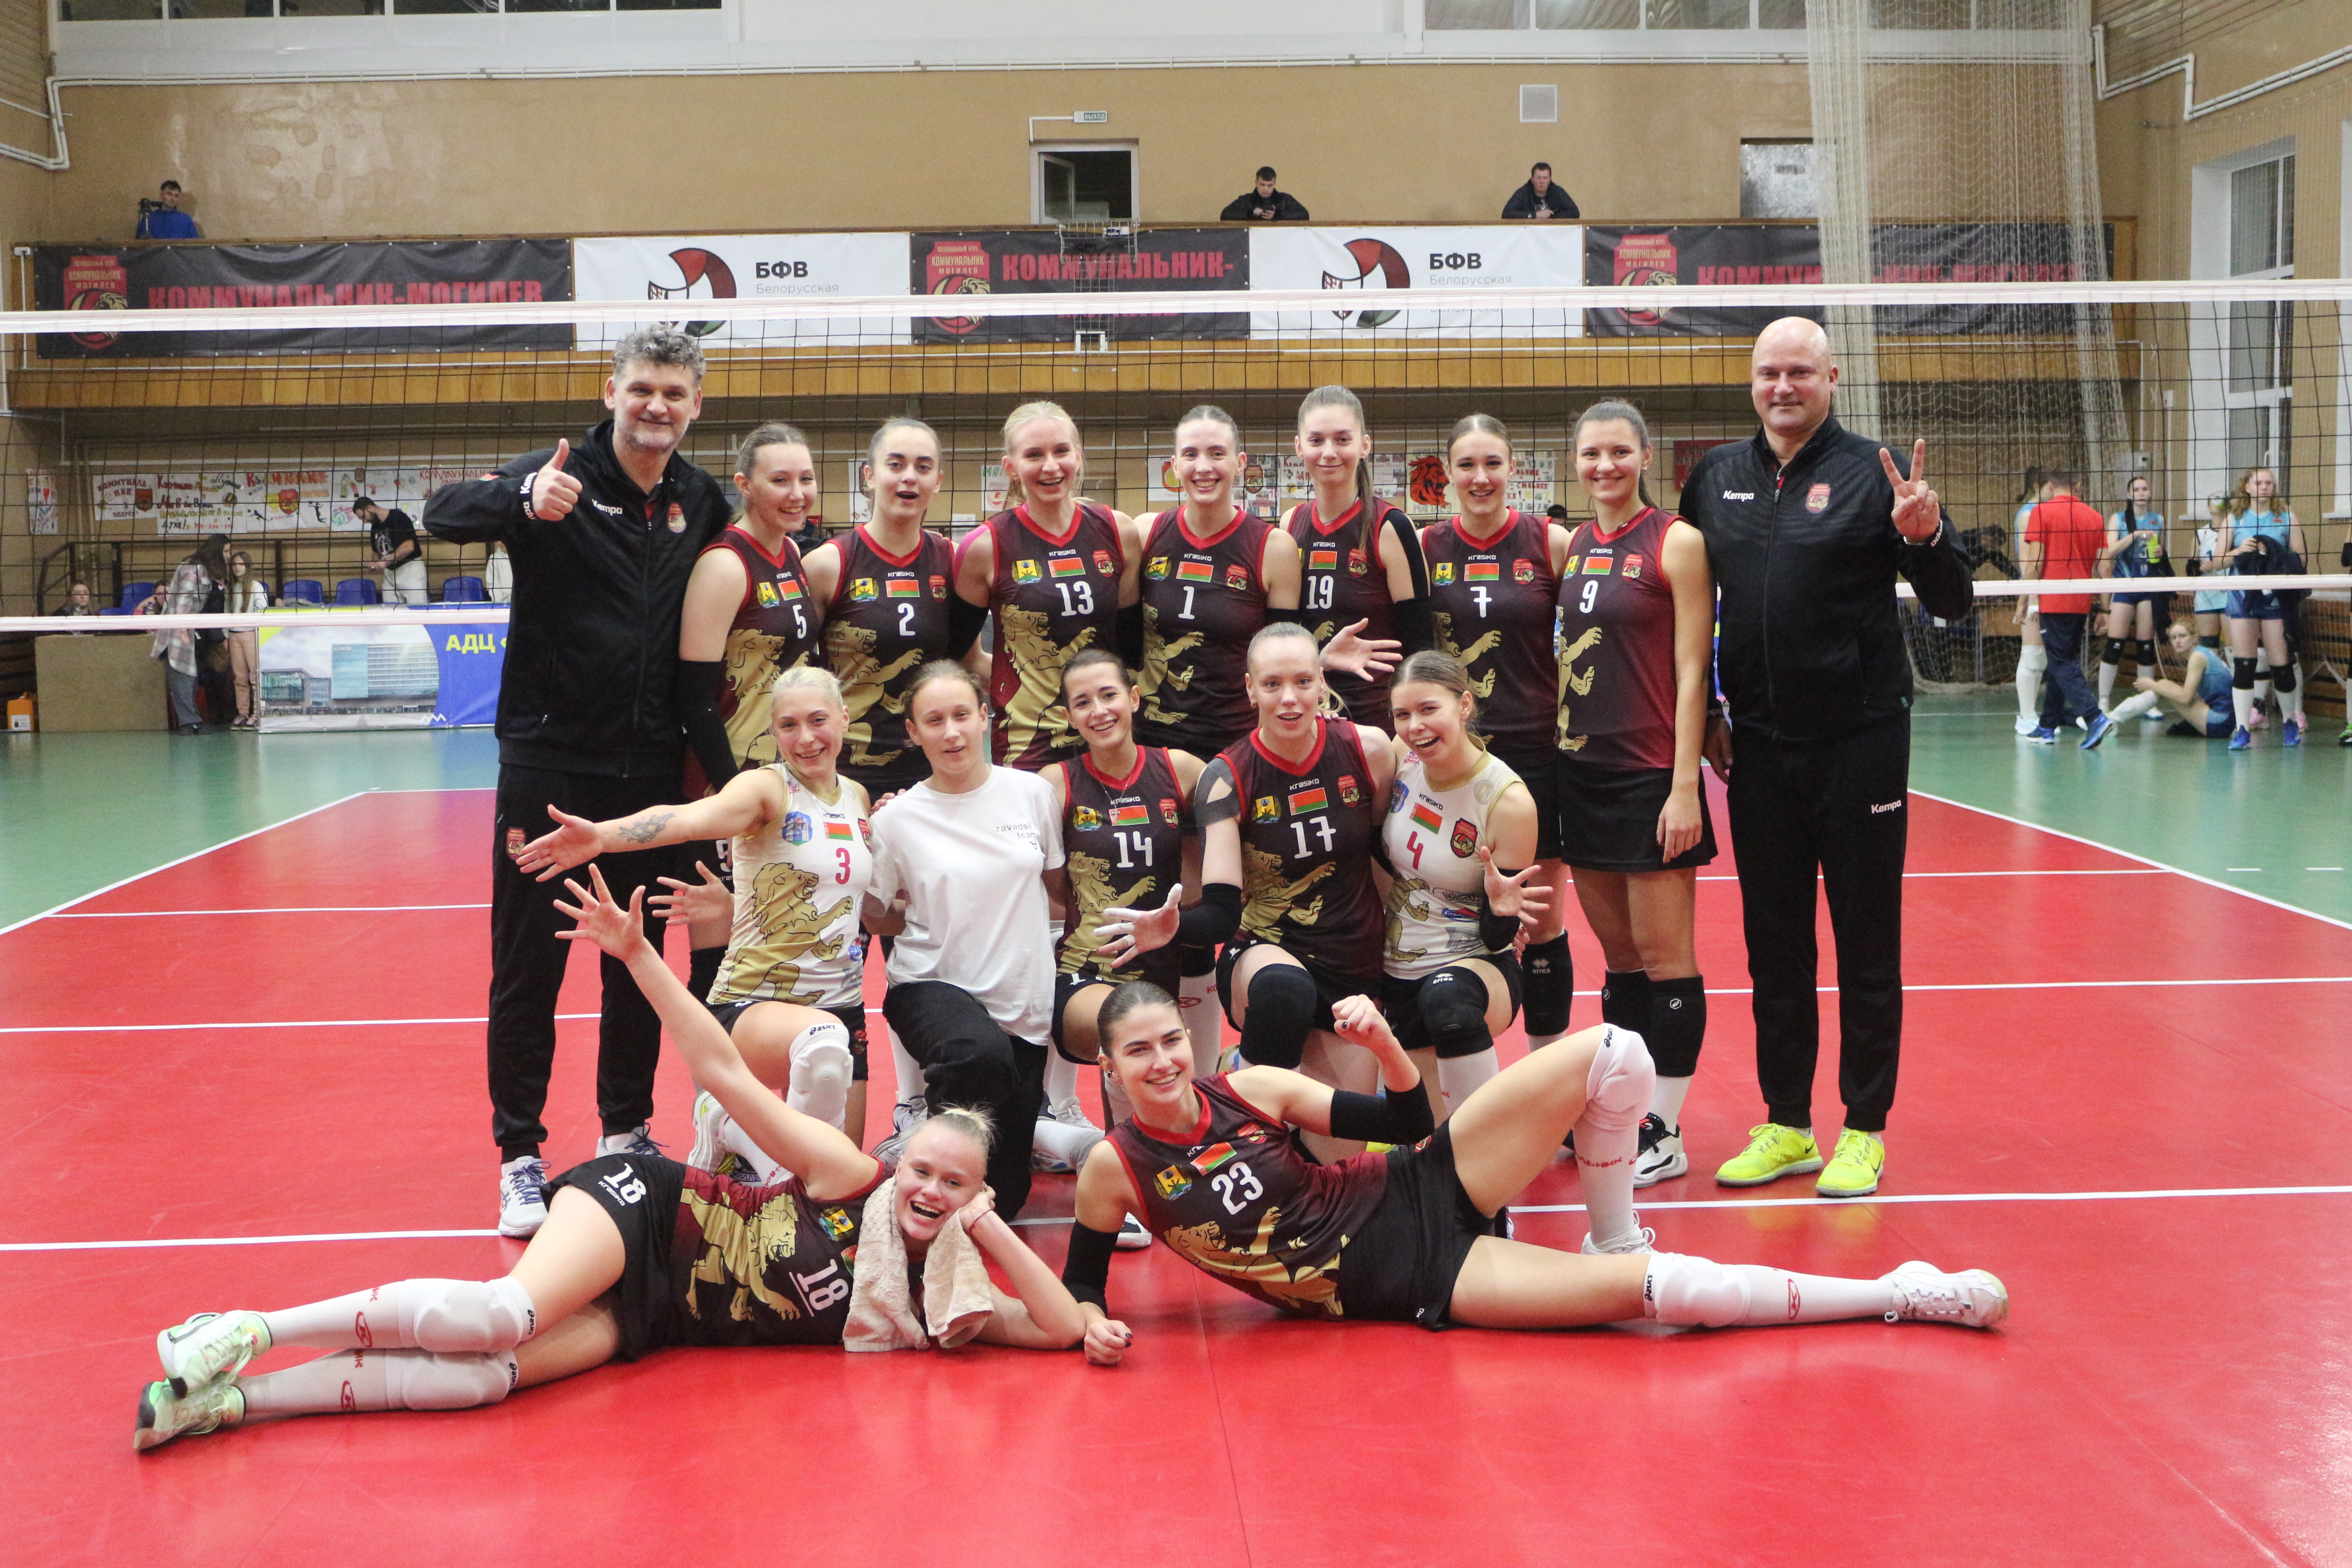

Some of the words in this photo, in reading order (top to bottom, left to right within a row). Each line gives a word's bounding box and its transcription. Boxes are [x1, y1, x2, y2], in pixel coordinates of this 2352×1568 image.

[756, 261, 808, 279] БФВ
[932, 255, 984, 266] КОММУНАЛЬНИК
[1430, 253, 1482, 270] БФВ
[756, 284, 839, 295] Белорусская
[1430, 275, 1512, 286] Белорусская
[592, 499, 623, 516] Kempa
[1723, 490, 1754, 502] Kempa
[1055, 580, 1094, 617] 13
[1178, 585, 1195, 620] 1
[1306, 575, 1334, 609] 19
[1470, 586, 1492, 618] 7
[1579, 580, 1598, 613] 9
[793, 604, 807, 639] 5
[897, 603, 916, 636] 2
[446, 633, 496, 654] АДЦ
[1871, 799, 1902, 814] Kempa
[1113, 831, 1153, 868] 14
[1290, 815, 1337, 859] 17
[1406, 831, 1424, 870] 4
[835, 847, 851, 885] 3
[603, 1162, 647, 1204] 18
[1211, 1161, 1264, 1215] 23
[796, 1258, 849, 1311] 18
